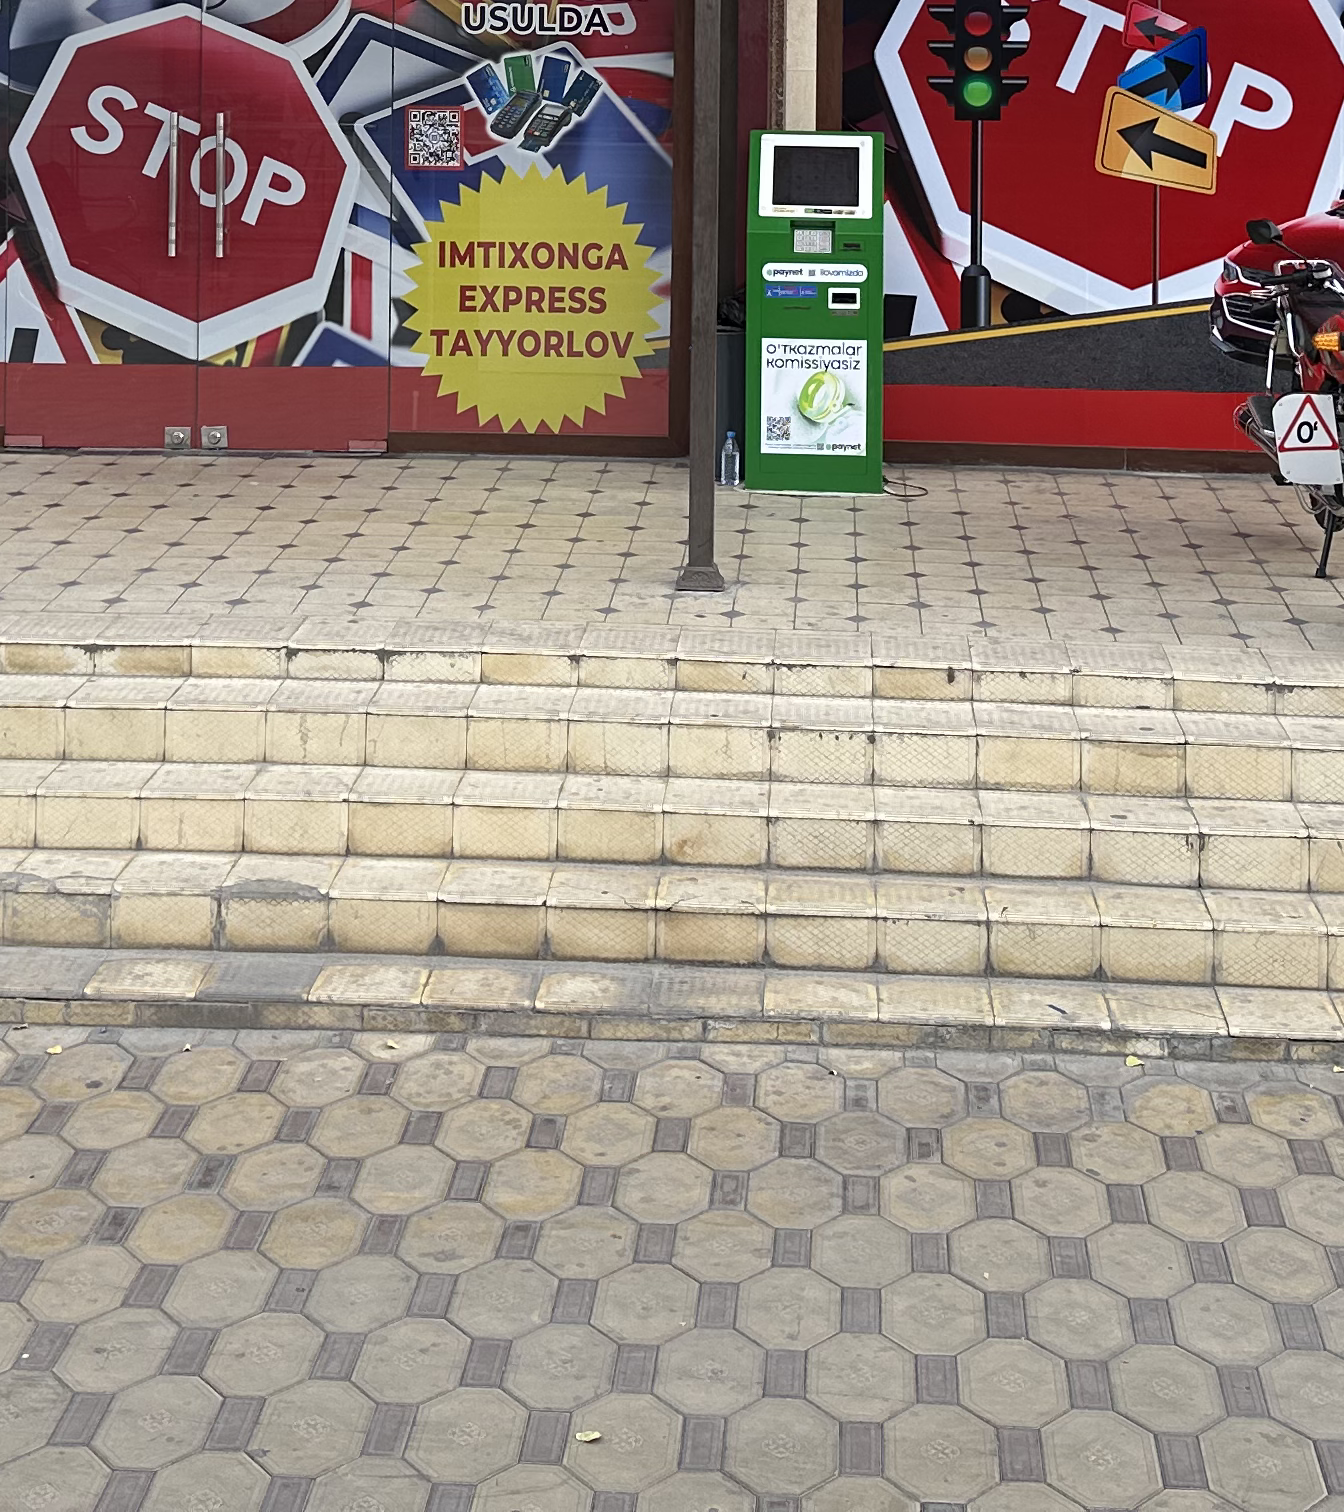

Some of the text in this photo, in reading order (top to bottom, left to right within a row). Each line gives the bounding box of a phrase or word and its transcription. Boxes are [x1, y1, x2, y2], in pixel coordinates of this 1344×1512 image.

[463, 5, 611, 34] USULDA
[70, 85, 306, 226] STOP
[437, 240, 629, 271] IMTIXONGA
[773, 268, 803, 277] paynet
[458, 285, 607, 315] EXPRESS
[430, 329, 634, 359] TAYYORLOV
